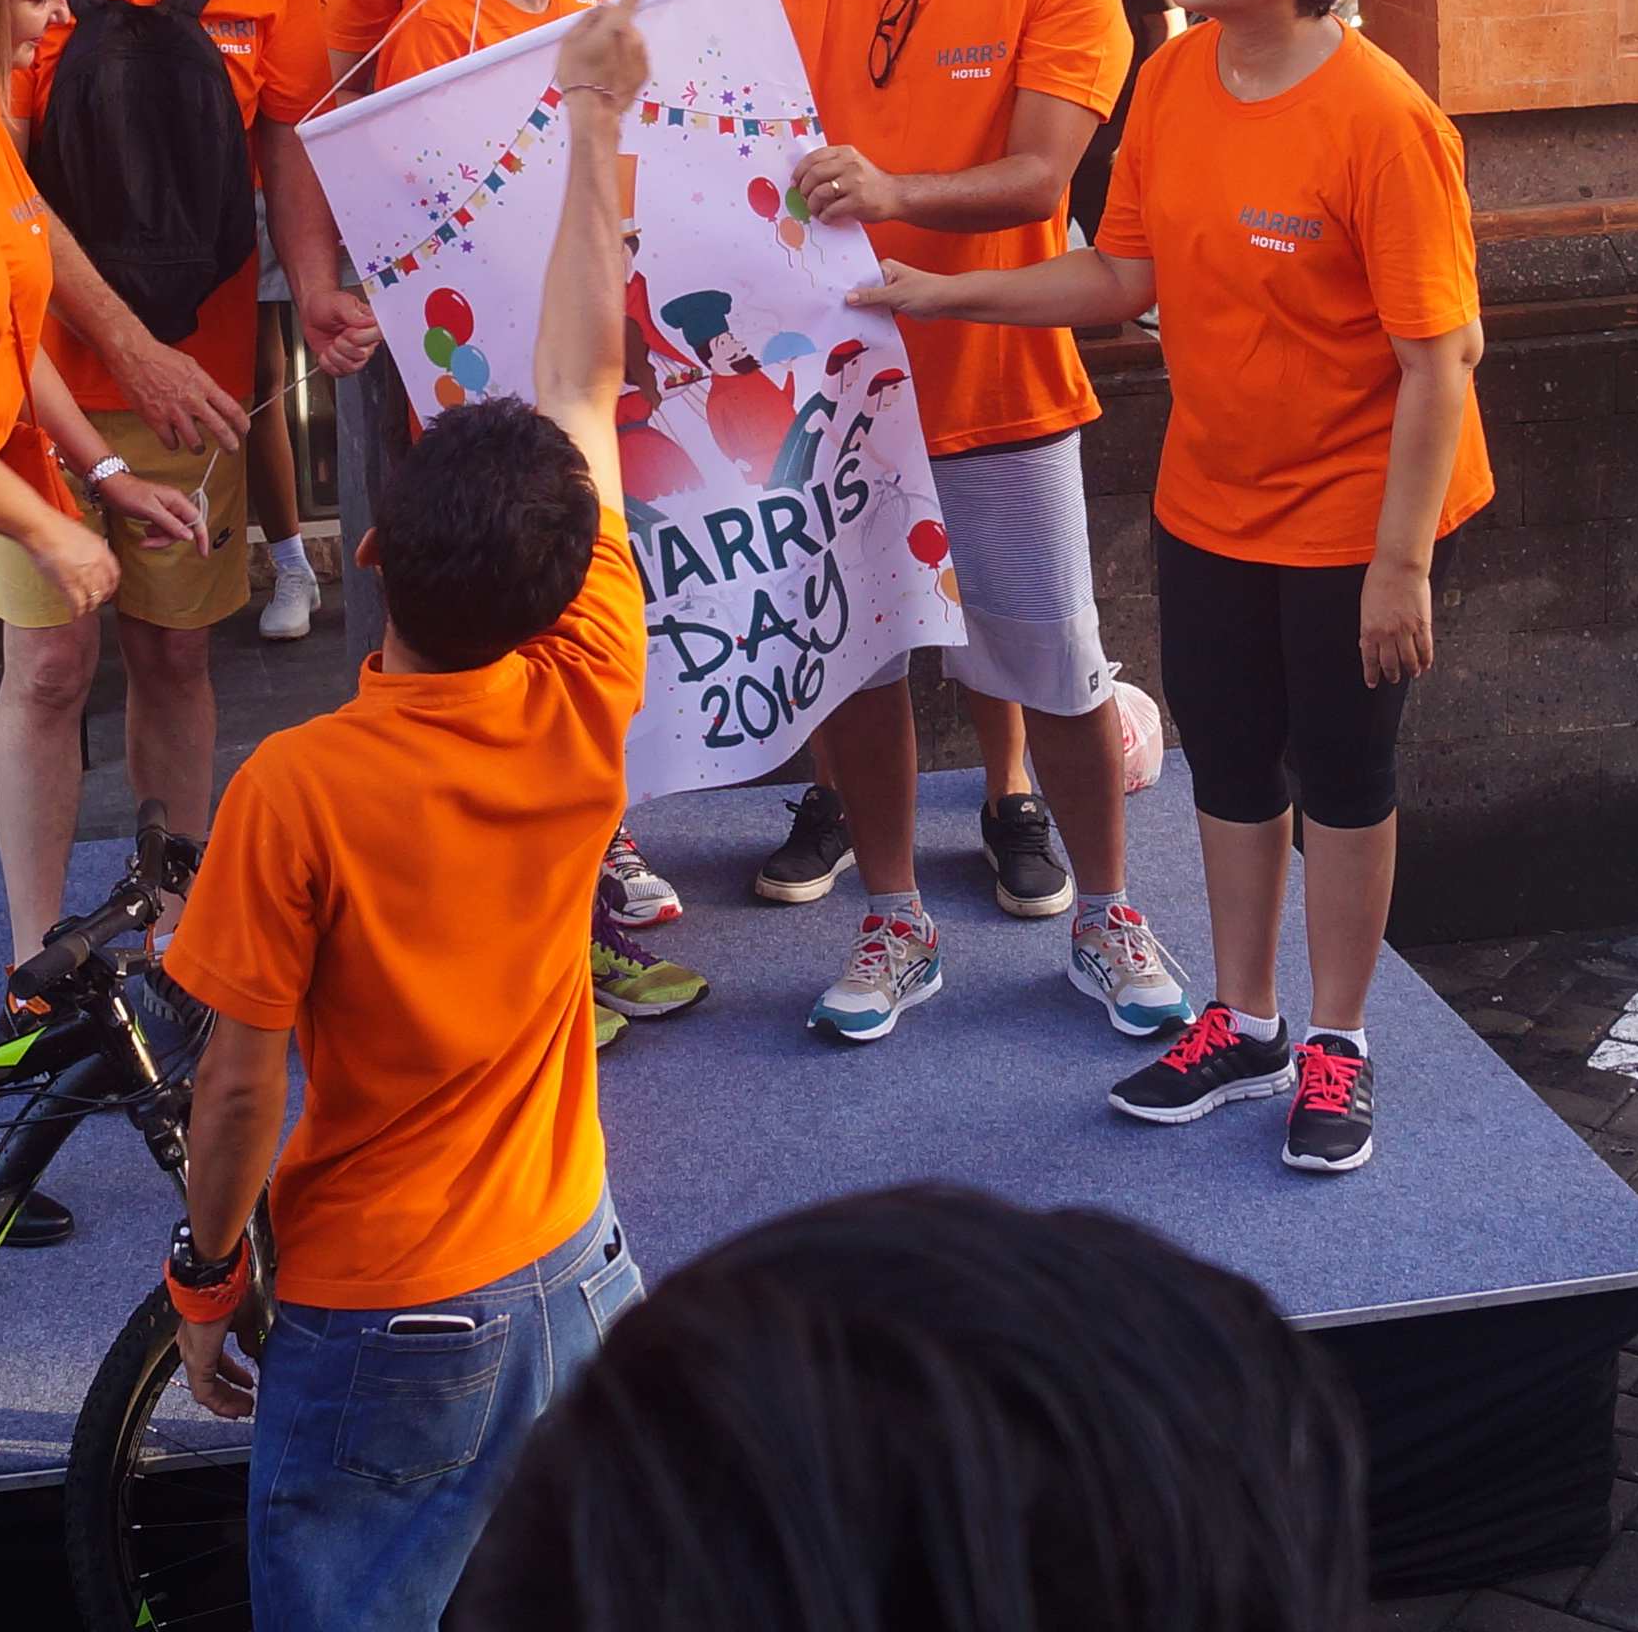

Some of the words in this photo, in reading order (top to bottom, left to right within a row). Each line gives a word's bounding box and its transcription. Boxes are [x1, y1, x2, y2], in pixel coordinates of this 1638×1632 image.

[218, 44, 251, 54] OTELS
[951, 67, 992, 80] HOTELS
[1239, 205, 1323, 240] HARRIS
[1250, 234, 1296, 254] HOTELS
[647, 548, 849, 683] DAY
[700, 652, 825, 748] 2016
